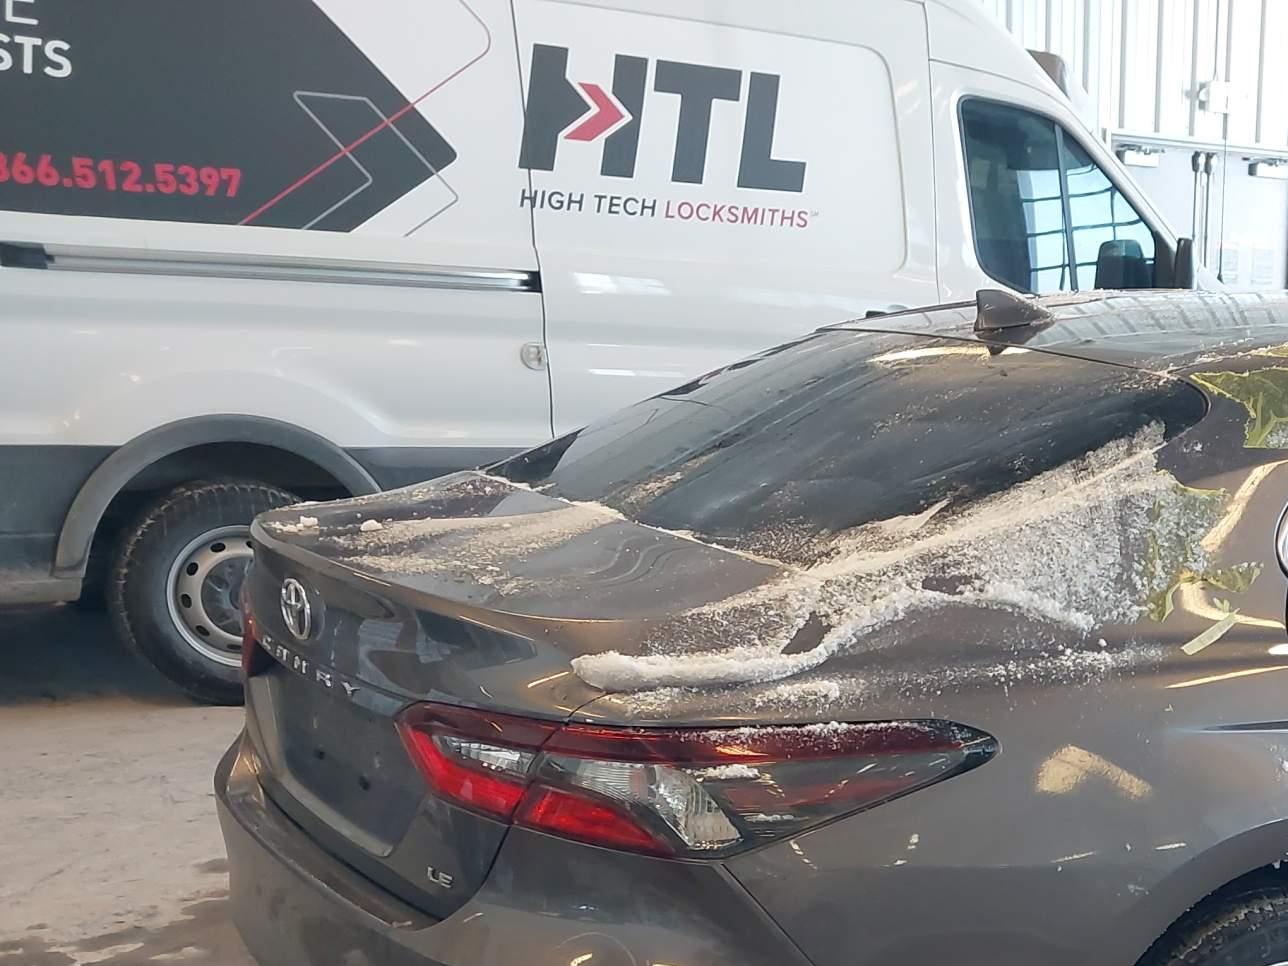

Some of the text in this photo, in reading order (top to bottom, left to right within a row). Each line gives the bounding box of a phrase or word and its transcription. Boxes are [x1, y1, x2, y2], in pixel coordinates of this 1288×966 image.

[518, 43, 807, 193] HTL
[519, 188, 809, 229] HIGH TECH LOCKSMITHS
[427, 866, 453, 889] LE
